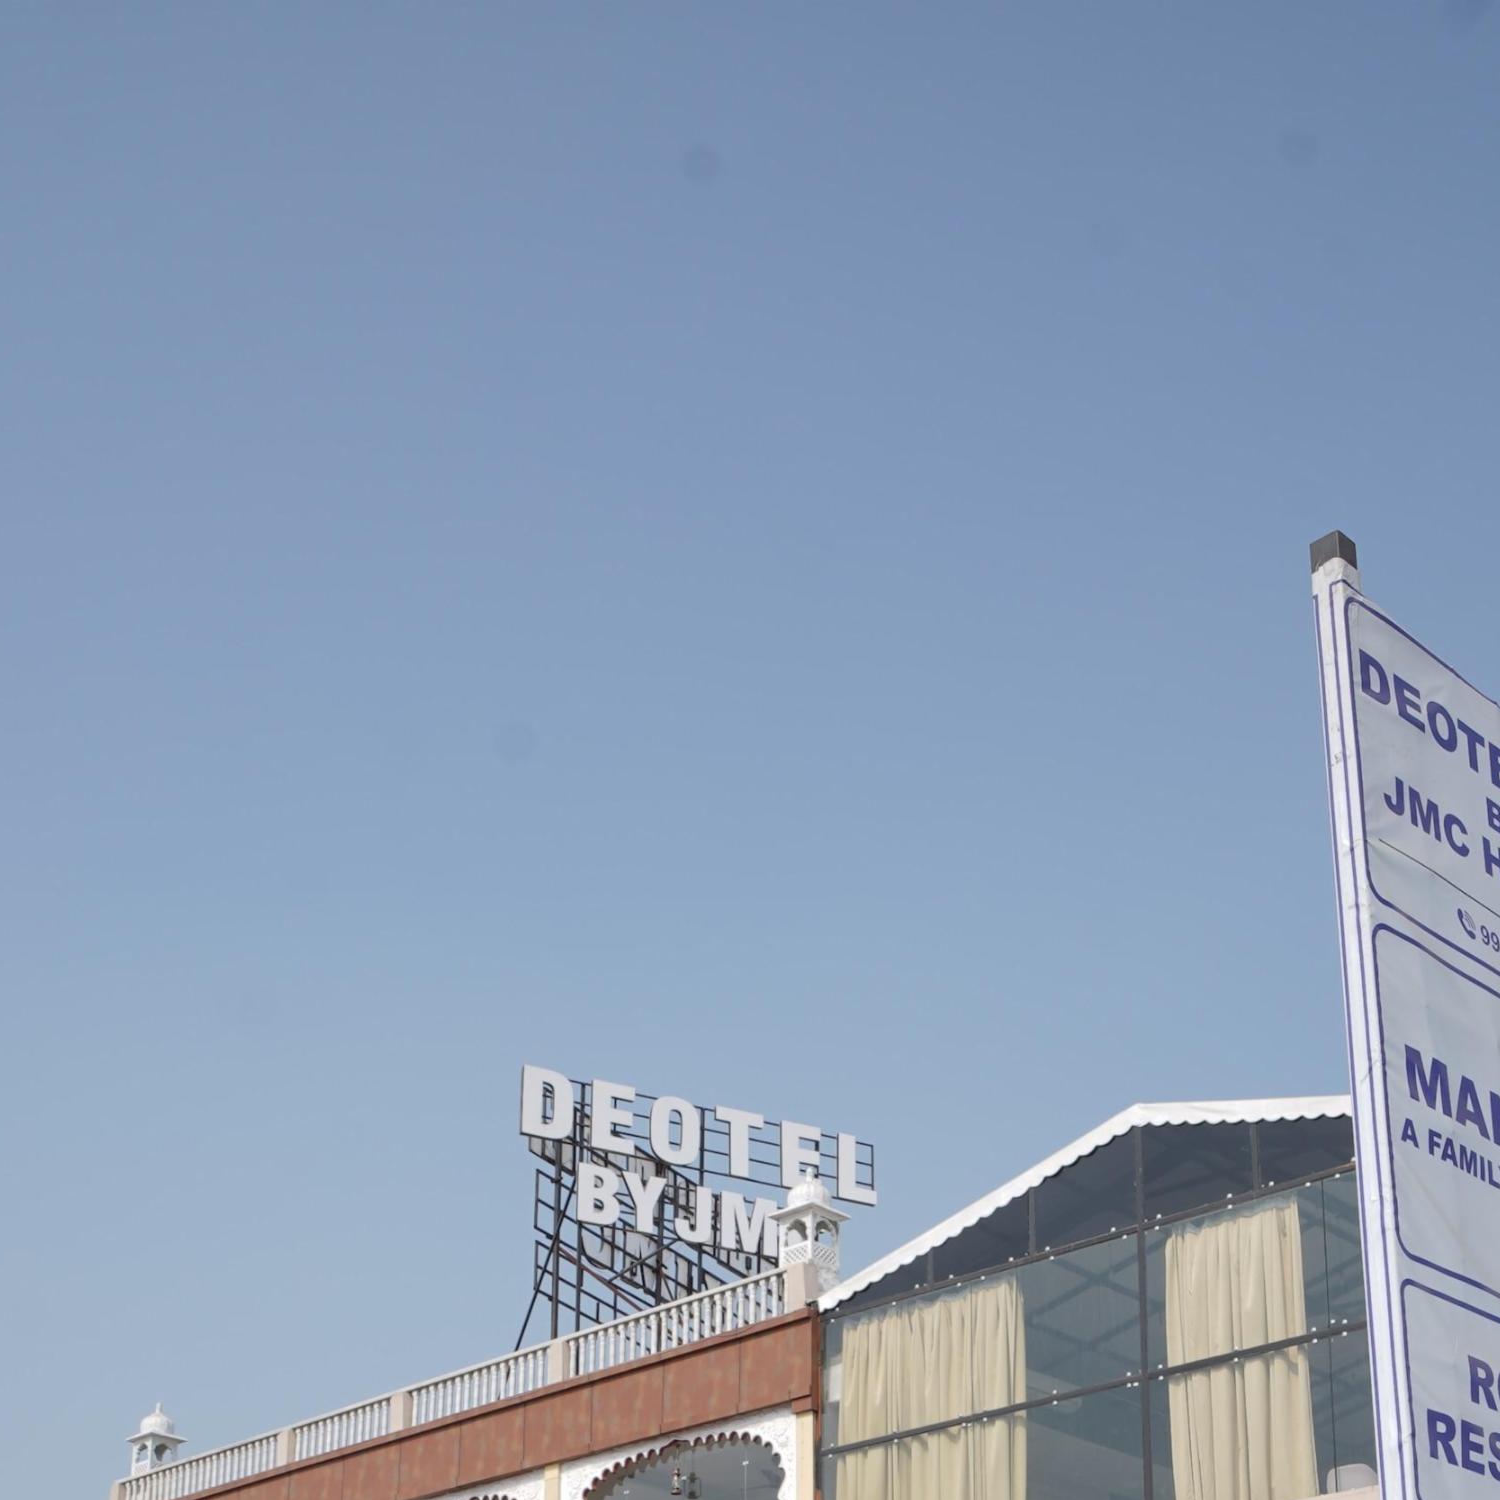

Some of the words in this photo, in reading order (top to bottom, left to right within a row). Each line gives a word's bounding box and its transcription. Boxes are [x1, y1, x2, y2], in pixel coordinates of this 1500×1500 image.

[1383, 776, 1469, 858] JMC
[520, 1064, 878, 1207] DEOTEL
[1401, 1117, 1418, 1149] A
[576, 1162, 668, 1234] BY
[674, 1186, 790, 1260] JM
